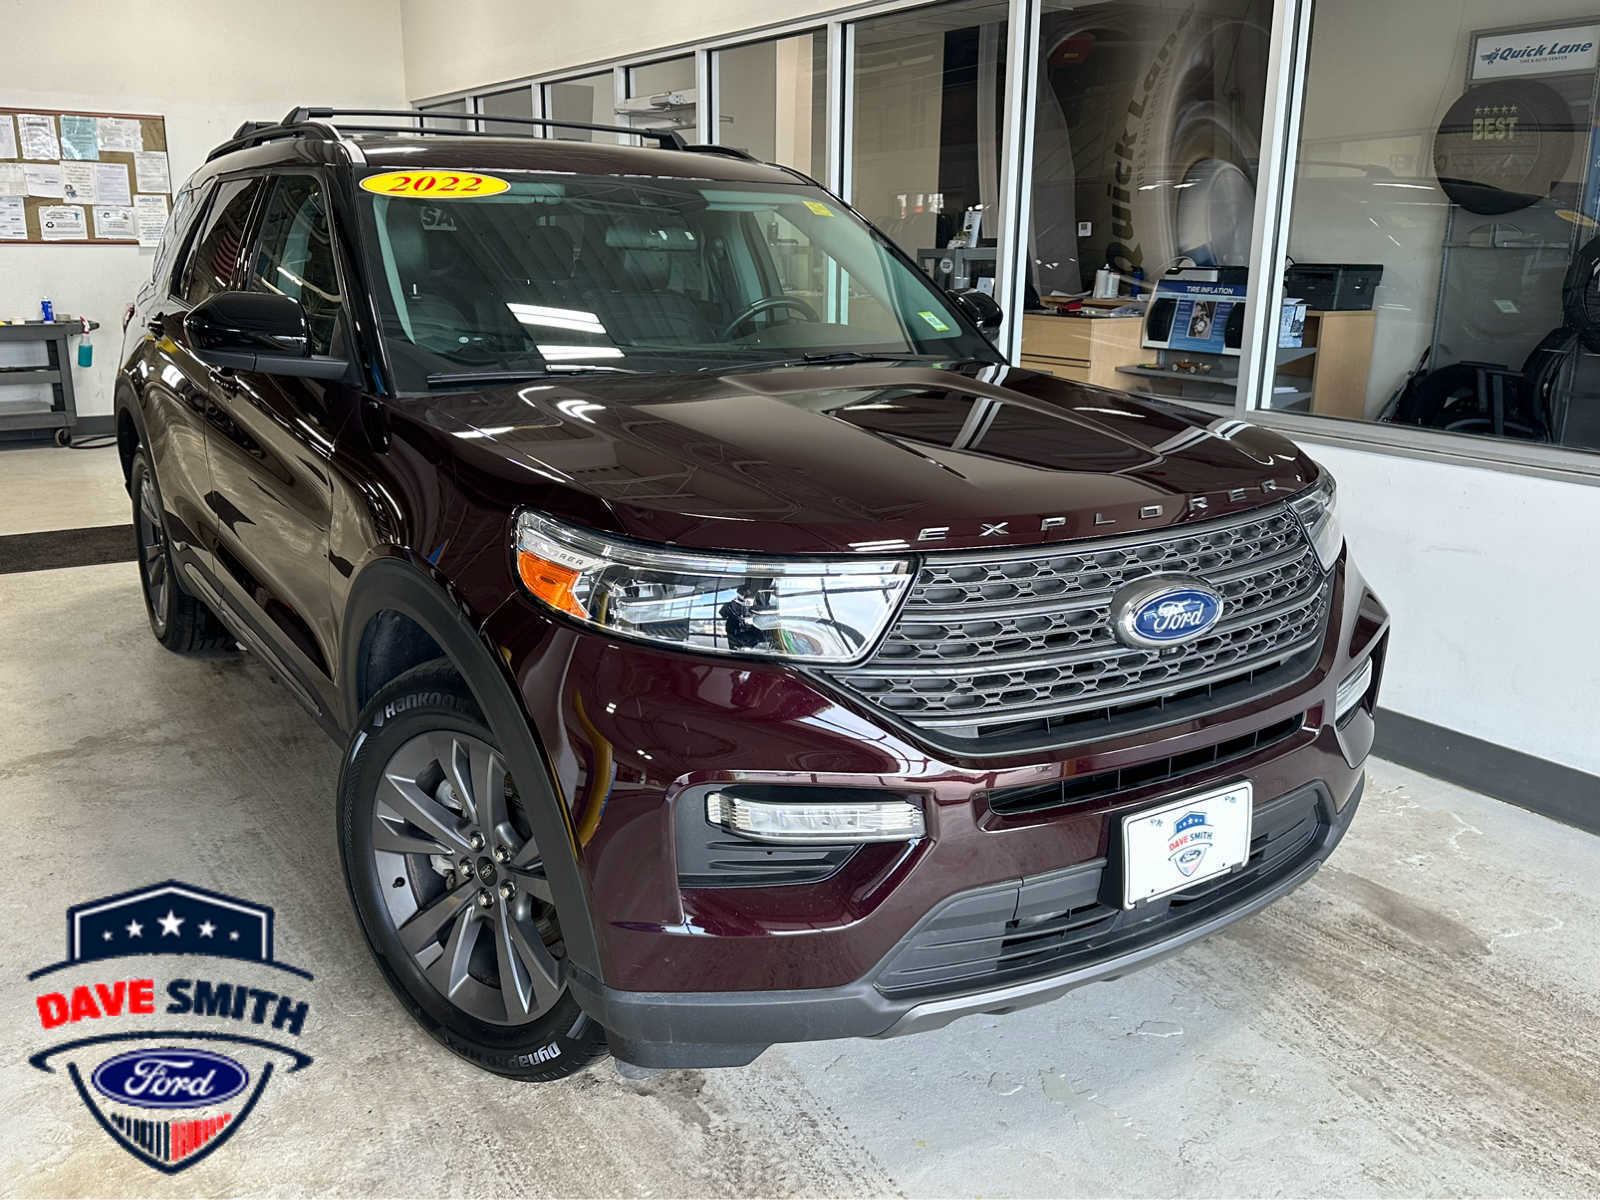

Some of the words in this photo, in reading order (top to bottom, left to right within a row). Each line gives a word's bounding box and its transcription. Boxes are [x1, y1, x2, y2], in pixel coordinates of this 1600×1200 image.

[1500, 43, 1546, 60] Quick
[1548, 42, 1593, 55] Lane
[1472, 117, 1519, 141] BEST
[387, 176, 483, 192] 2022
[1105, 126, 1143, 278] Quick
[1186, 285, 1200, 293] TIRE
[1201, 286, 1234, 295] INFLATION
[917, 478, 1277, 542] EXPLORER
[1153, 598, 1205, 634] Ford
[1169, 836, 1189, 851] DAVE
[1190, 832, 1213, 842] SMITH
